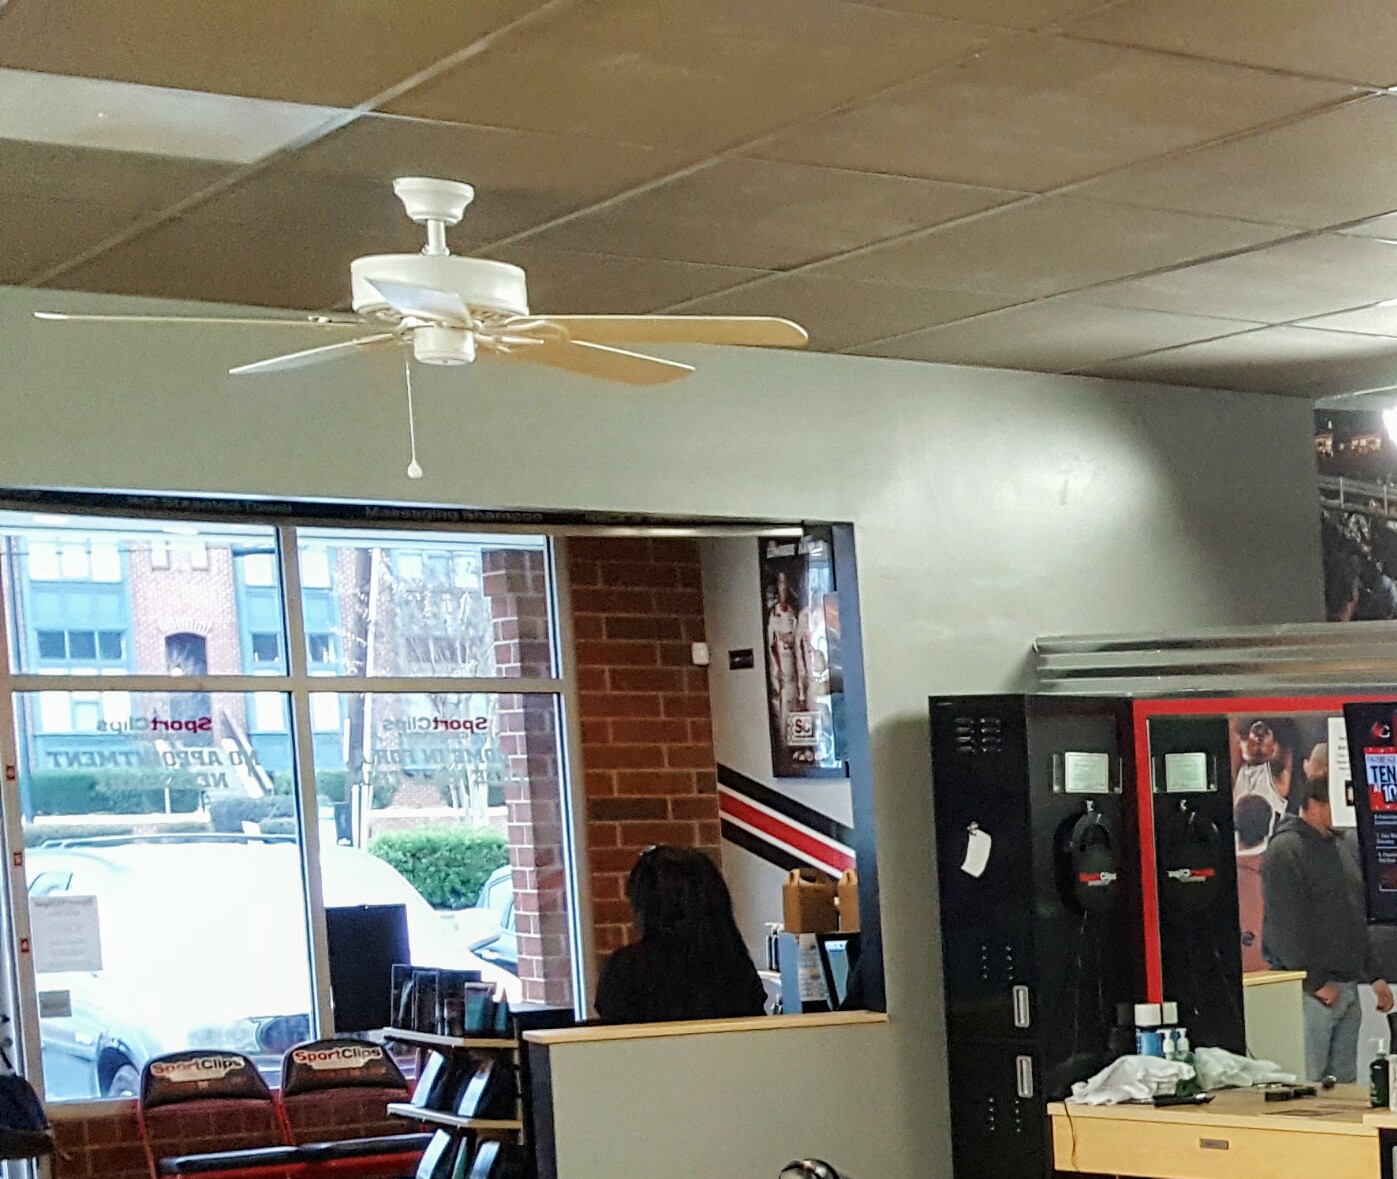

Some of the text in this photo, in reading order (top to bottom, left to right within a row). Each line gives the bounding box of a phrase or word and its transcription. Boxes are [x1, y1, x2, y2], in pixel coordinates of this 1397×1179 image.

[1370, 765, 1396, 783] TEN
[294, 1047, 382, 1062] SportClips
[152, 1058, 244, 1075] SportClips
